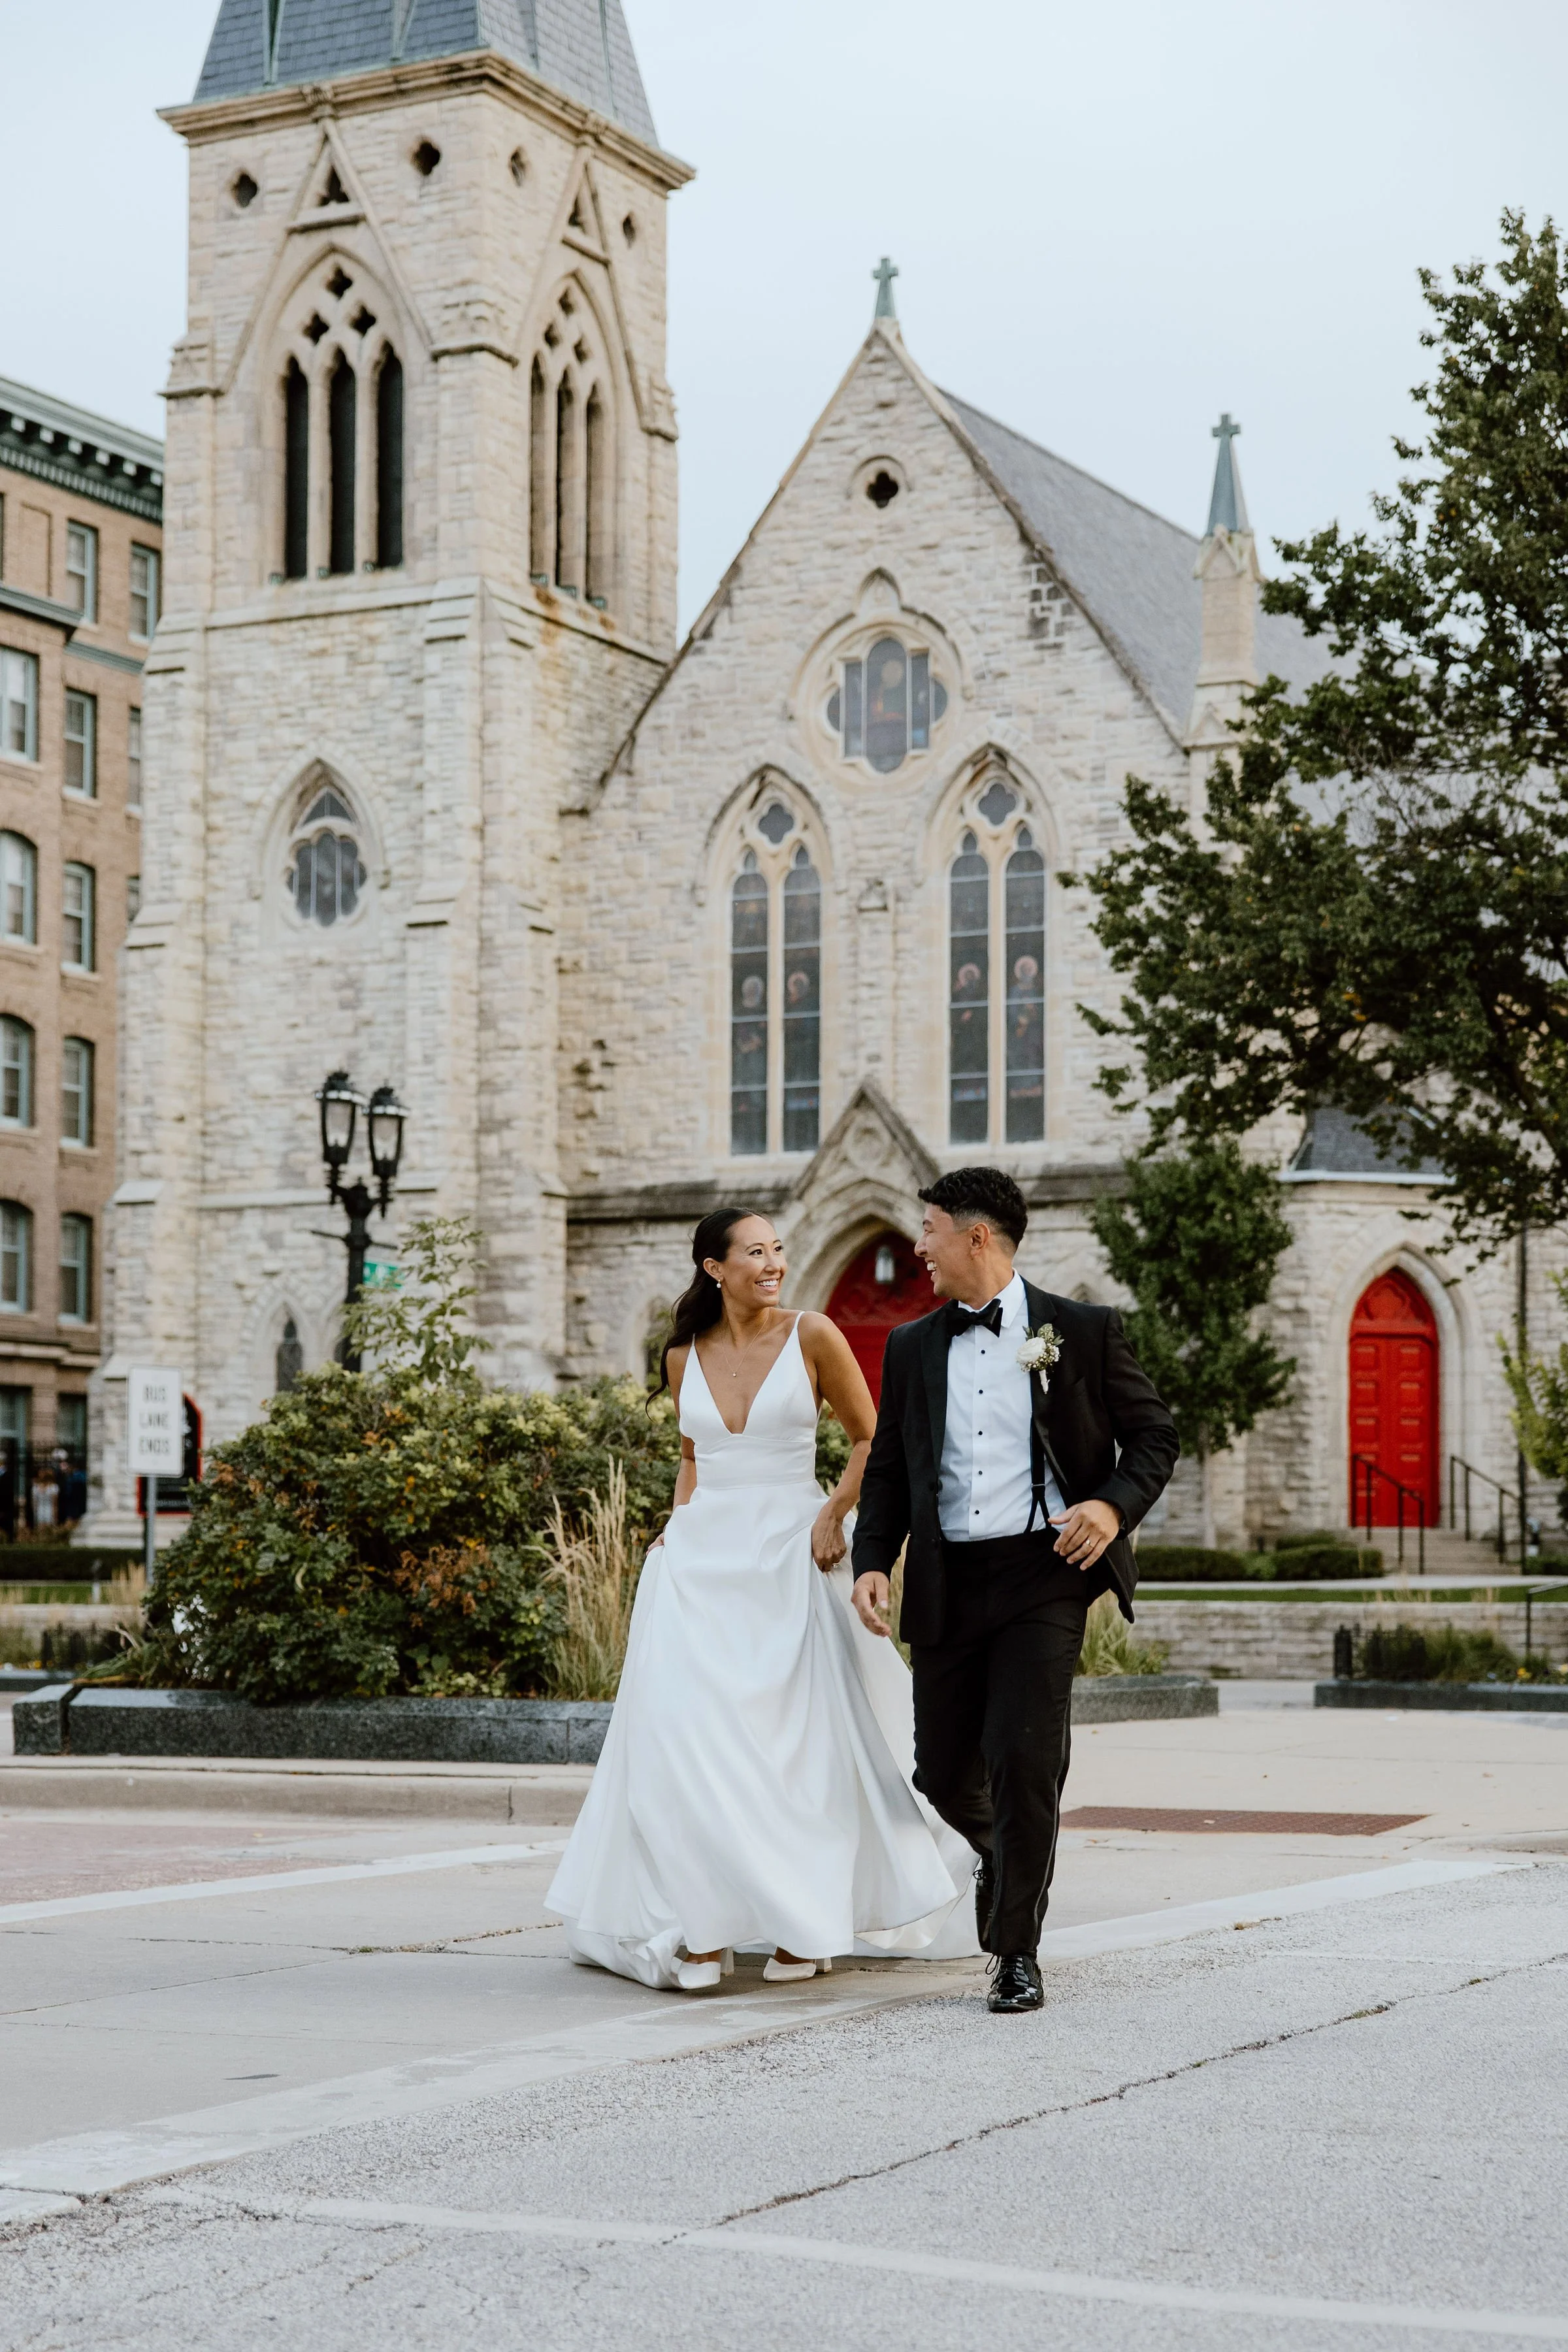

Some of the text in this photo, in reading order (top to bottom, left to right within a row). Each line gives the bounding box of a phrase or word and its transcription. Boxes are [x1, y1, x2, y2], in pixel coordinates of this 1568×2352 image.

[144, 1384, 167, 1401] BUS
[139, 1412, 170, 1429] LANE
[139, 1438, 170, 1455] ENDS
